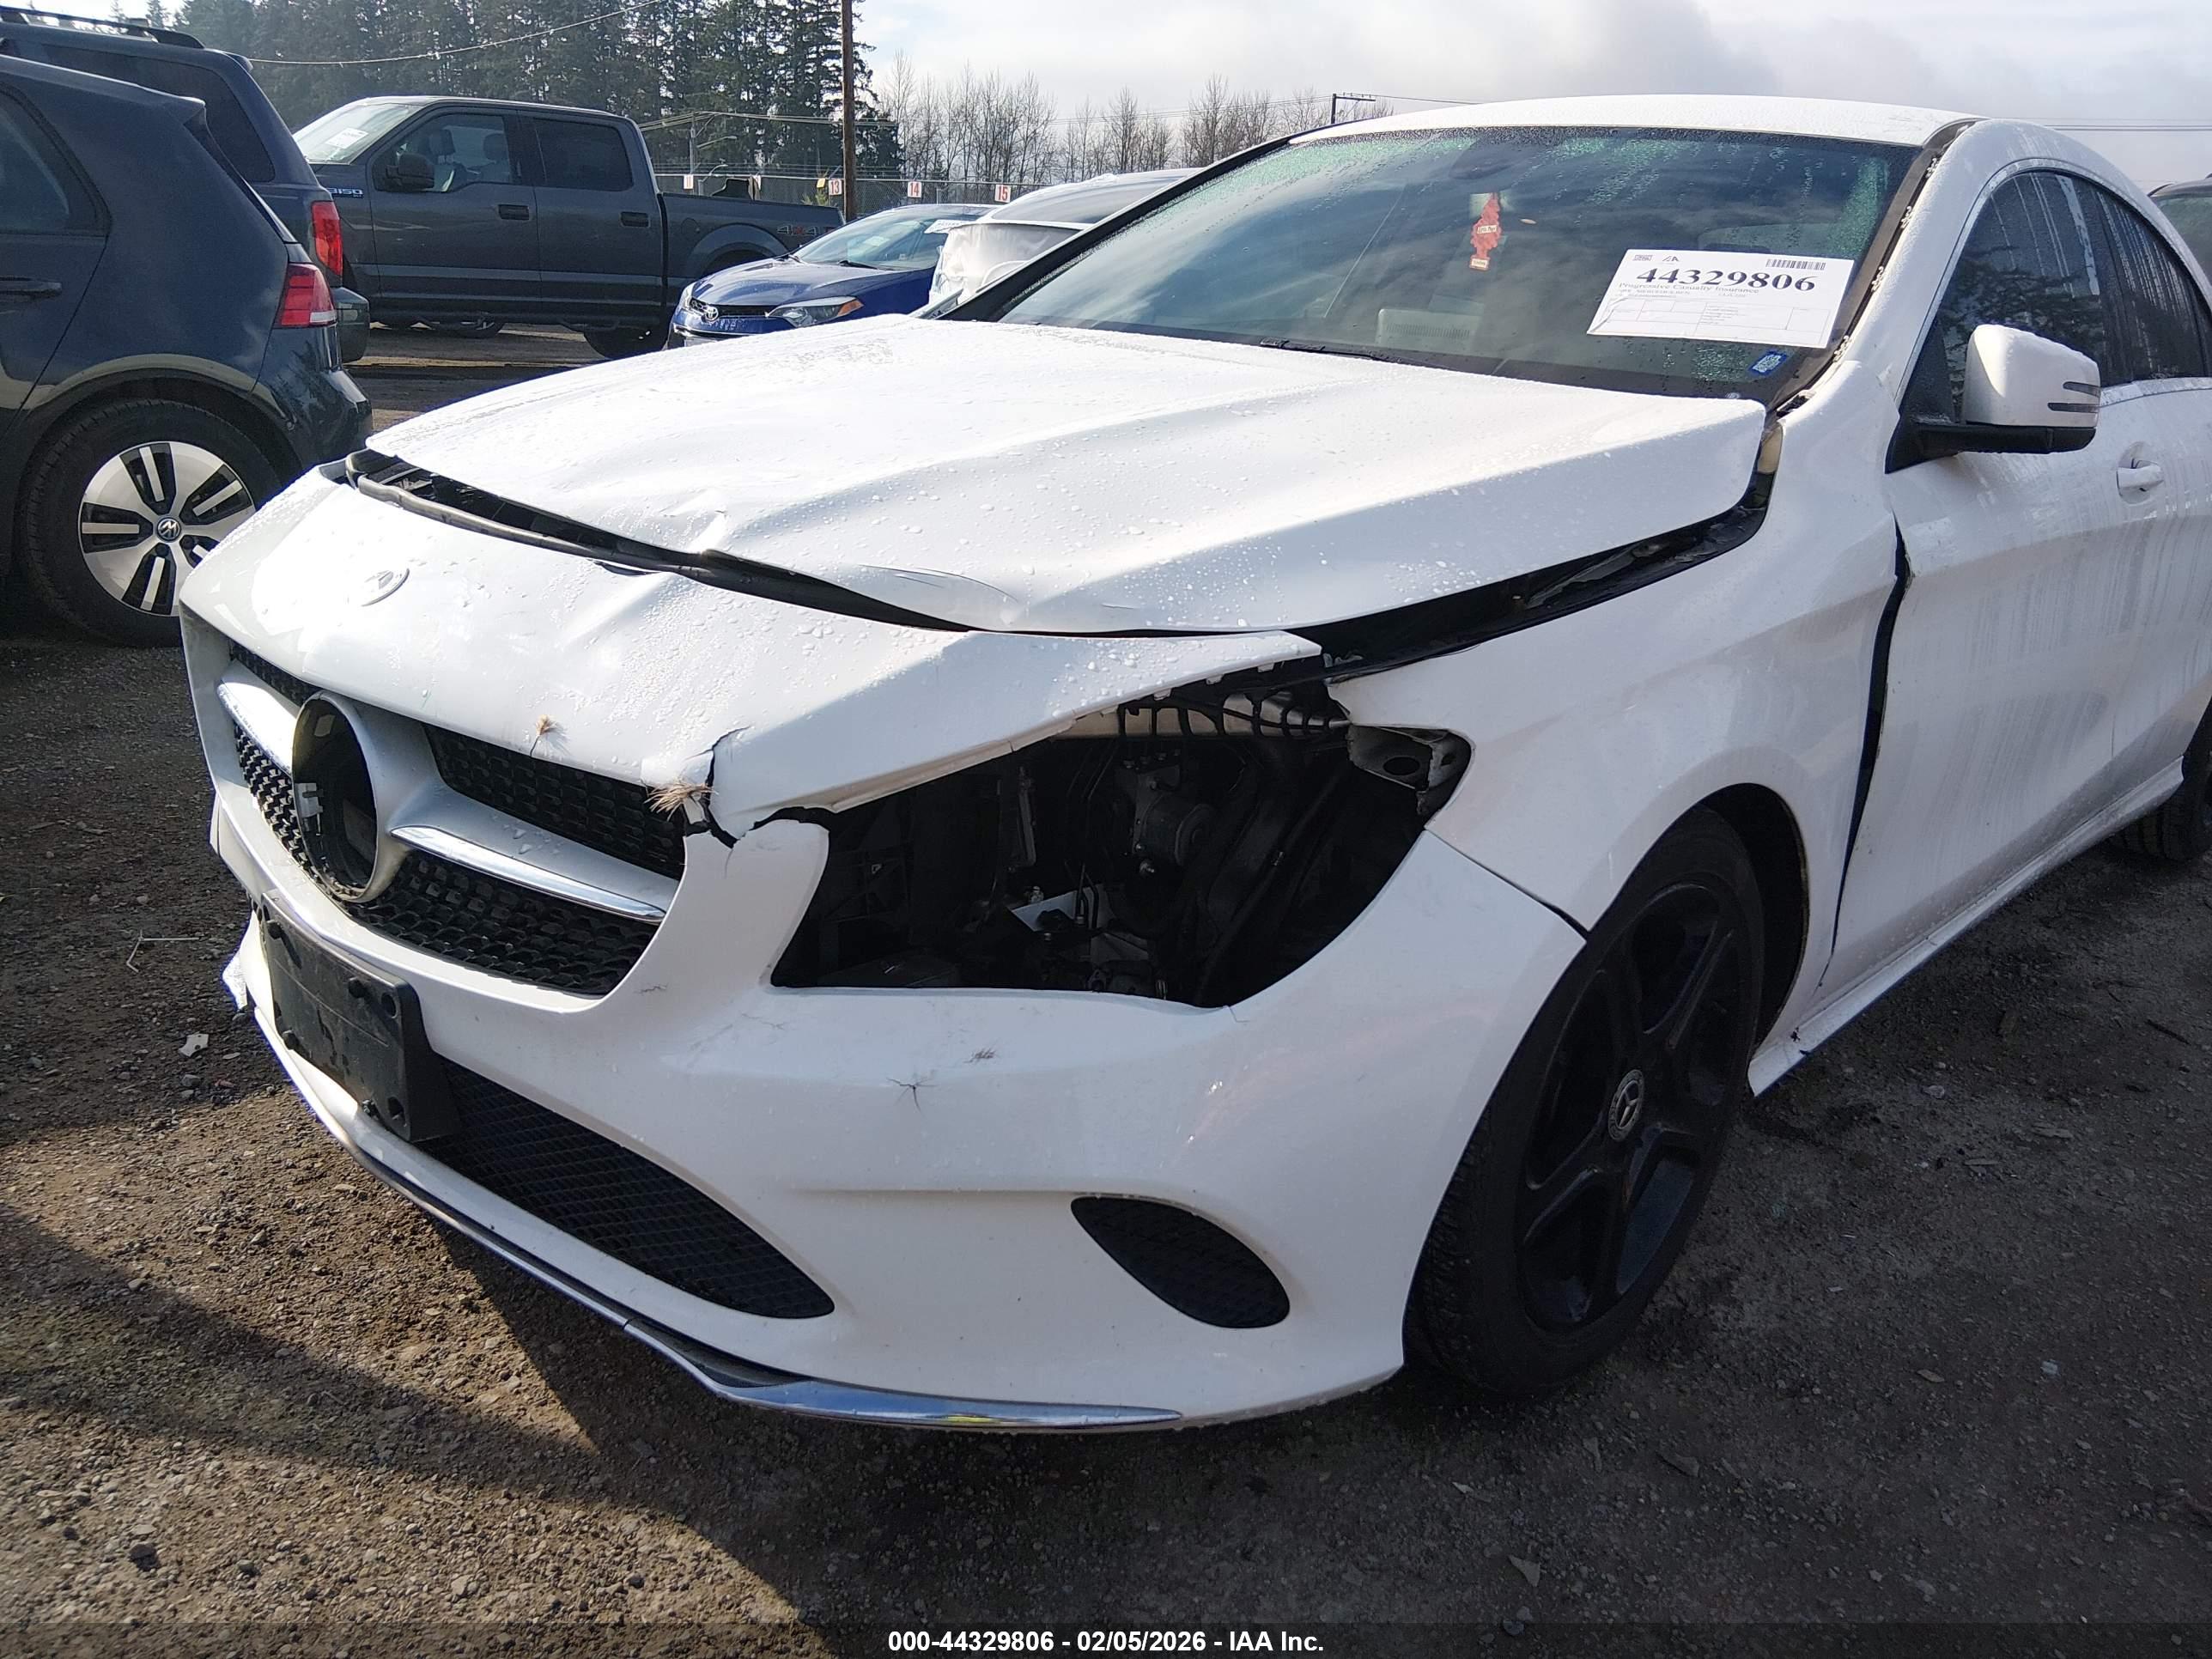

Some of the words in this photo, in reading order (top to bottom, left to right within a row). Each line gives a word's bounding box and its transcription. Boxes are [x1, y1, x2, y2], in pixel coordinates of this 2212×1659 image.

[830, 180, 840, 194] 13
[910, 182, 920, 197] 14
[998, 185, 1009, 201] 15
[1637, 268, 1820, 292] 44329806
